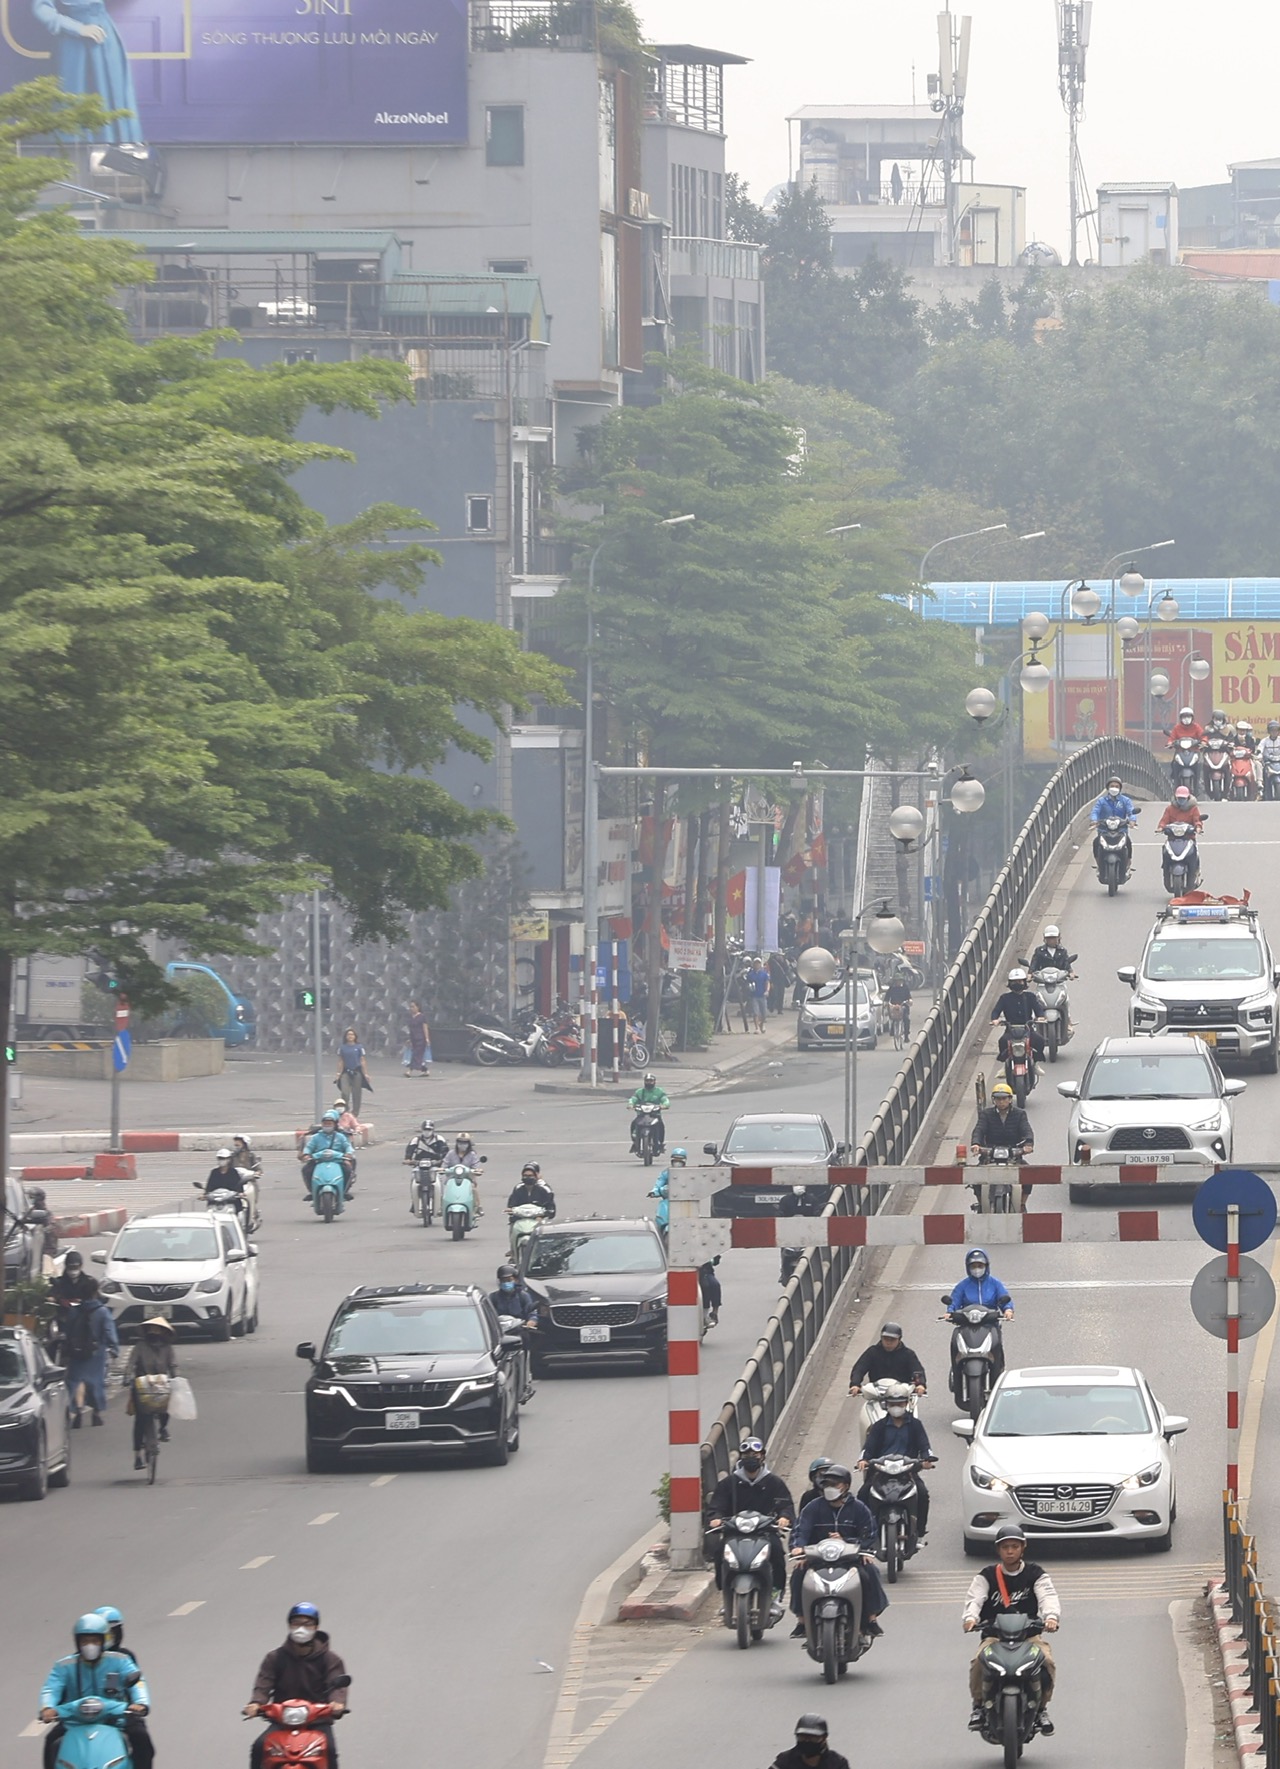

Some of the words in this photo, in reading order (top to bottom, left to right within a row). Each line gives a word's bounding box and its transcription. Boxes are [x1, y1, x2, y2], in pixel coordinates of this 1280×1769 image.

[374, 111, 449, 124] AkzoNobel
[1219, 663, 1261, 704] BỔ
[1038, 1501, 1091, 1512] 30F-814.29
